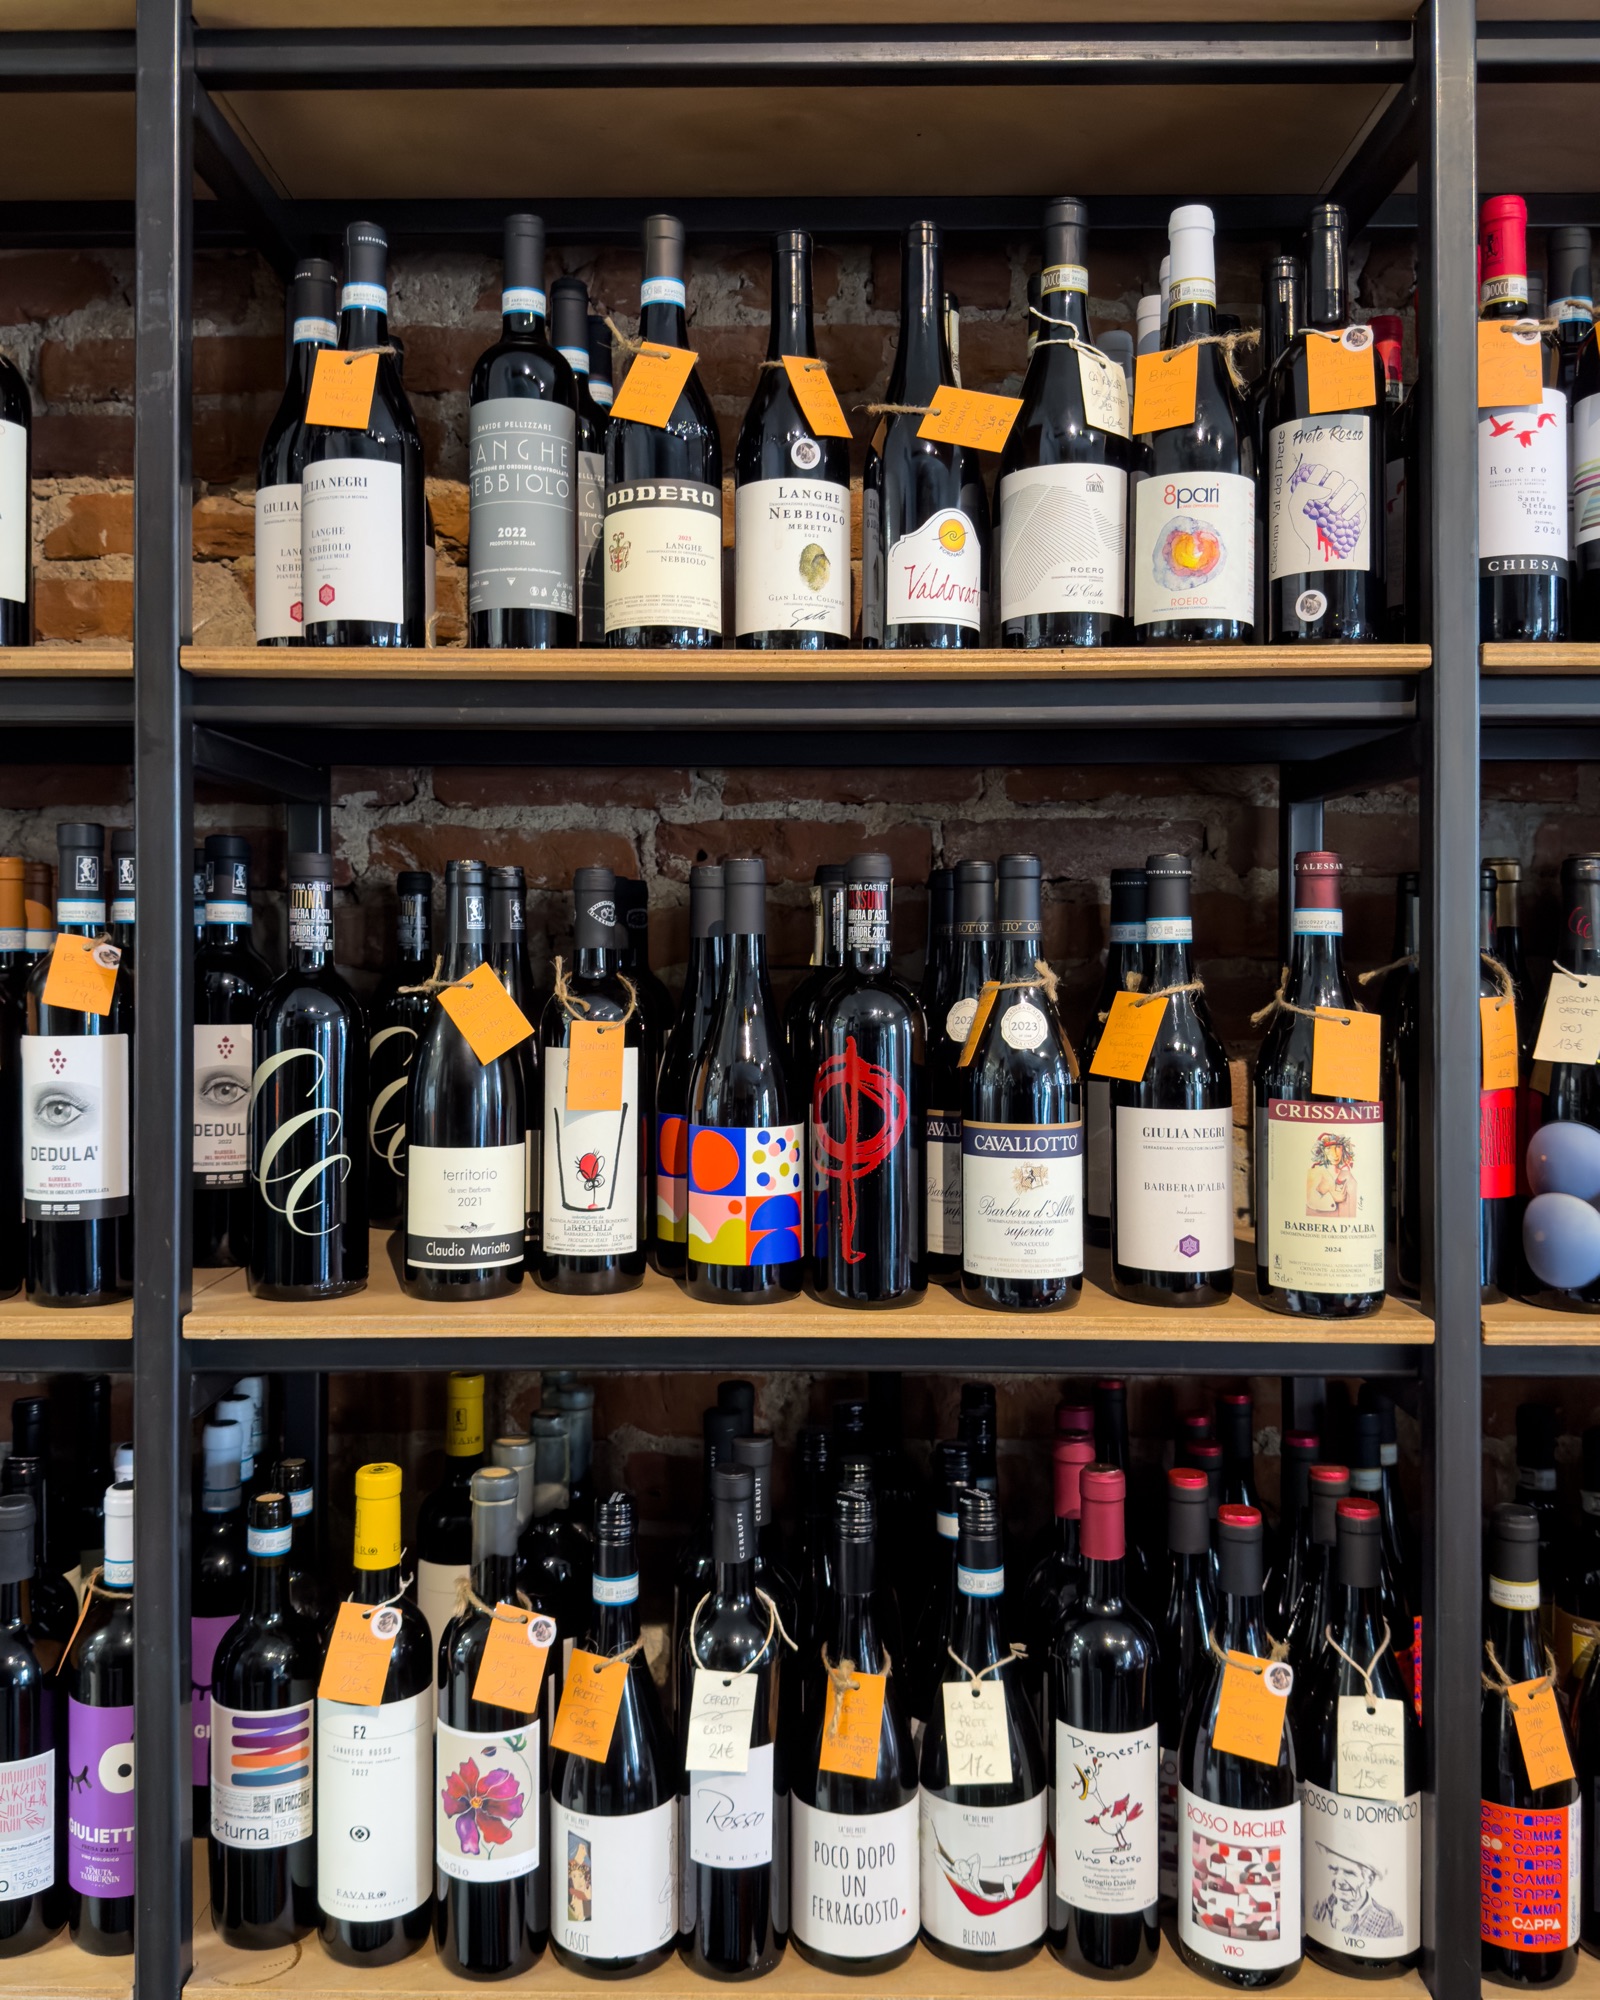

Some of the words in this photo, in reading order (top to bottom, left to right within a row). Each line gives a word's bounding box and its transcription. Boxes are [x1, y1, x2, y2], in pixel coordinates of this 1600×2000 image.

[477, 422, 501, 433] DAVIDE
[505, 421, 551, 432] PELLIZZARI
[1329, 425, 1364, 443] Rosso
[1274, 429, 1287, 475] Prete
[506, 463, 532, 471] ORIGINE
[534, 465, 569, 477] CONTROLLATA
[1489, 465, 1547, 476] Roero
[329, 476, 368, 489] NEGRI
[1274, 475, 1283, 497] del
[607, 486, 714, 509] ODDERO
[778, 486, 840, 504] LANGHE
[1163, 483, 1220, 509] 8pari
[1517, 494, 1546, 502] Santo
[264, 501, 299, 514] GIULIA
[1271, 496, 1282, 519] Val
[1521, 501, 1556, 510] Stefano
[1526, 508, 1553, 516] Roero
[769, 507, 845, 526] NEBBIOLO
[312, 526, 345, 539] LANGHE
[497, 527, 527, 538] 2022
[788, 523, 832, 533] MERETTA
[1534, 525, 1562, 536] 2020
[308, 543, 351, 555] NEBBIOLO
[665, 542, 703, 553] LANGHE
[1269, 524, 1280, 574] Cascina
[661, 555, 706, 567] NEBBIOLO
[1487, 559, 1559, 572] CHIESA
[1070, 566, 1105, 575] ROERO
[768, 593, 789, 602] GIAN
[792, 593, 813, 601] LUCA
[1170, 596, 1208, 607] ROERO
[307, 883, 332, 892] CASTLET
[864, 883, 889, 892] CASTLET
[316, 926, 329, 937] 2021
[872, 927, 887, 938] 2021
[1010, 1021, 1038, 1031] 2023
[1552, 1038, 1584, 1051] 13€
[1275, 1103, 1381, 1120] CRISSANTE
[1142, 1126, 1190, 1139] GIULIA
[1193, 1126, 1225, 1139] NEGRI
[974, 1134, 1078, 1152] CAVALLOTTO
[443, 1167, 498, 1181] territorio
[1144, 1181, 1195, 1193] BARBERA
[1196, 1181, 1226, 1193] D'ALBA
[457, 1196, 483, 1207] 2021
[977, 1194, 1030, 1217] Barbera
[1033, 1194, 1076, 1218] d'Alba
[1004, 1224, 1055, 1241] superiore
[1284, 1220, 1337, 1233] BARBERA
[1340, 1223, 1375, 1233] D'ALBA
[425, 1240, 466, 1257] Claudio
[470, 1241, 511, 1257] Mariotto
[739, 1512, 747, 1559] CERRUTI
[353, 1725, 366, 1739] F2
[332, 1744, 364, 1757] CANAVESE
[368, 1746, 392, 1756] ROSSO
[1066, 1733, 1152, 1761] Disonesta
[351, 1768, 369, 1777] 2022
[1353, 1768, 1389, 1790] 15€
[697, 1788, 766, 1831] Rosso
[1356, 1800, 1418, 1824] DOMENICO
[1187, 1802, 1229, 1833] ROSSO
[1233, 1818, 1287, 1838] BACHER
[282, 1828, 299, 1840] 750
[694, 1849, 770, 1863] CERRUTI
[814, 1840, 850, 1870] POCO
[857, 1842, 896, 1870] DOPO
[1075, 1849, 1101, 1865] Vino
[1109, 1854, 1142, 1866] Rosso
[13, 1865, 43, 1881] 13.5%
[84, 1865, 113, 1875] TENUTA
[21, 1878, 39, 1891] 750
[80, 1871, 120, 1885] TAMBURNIN
[1082, 1875, 1113, 1887] Garoglio
[1113, 1878, 1137, 1887] Davide
[841, 1874, 867, 1897] UN
[1511, 1916, 1562, 1931] CAPPA
[564, 1927, 591, 1954] CASOT
[962, 1928, 997, 1947] BLENDA
[1343, 1936, 1366, 1949] VINO
[1222, 1943, 1244, 1957] VINO
